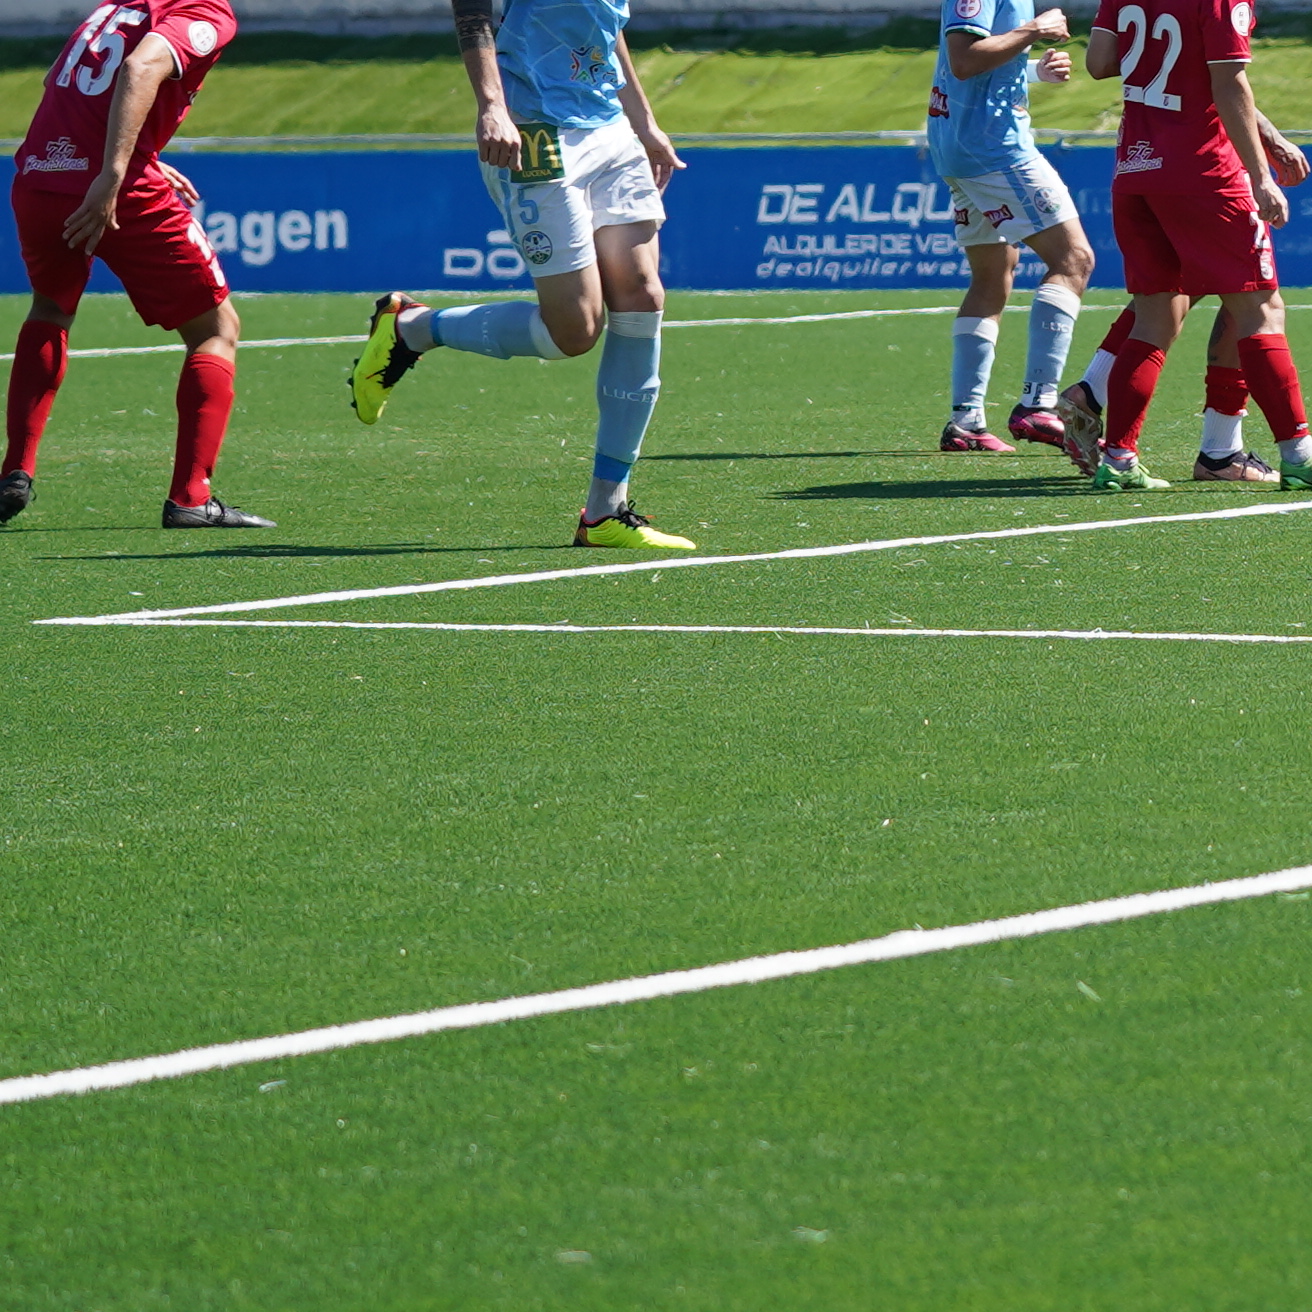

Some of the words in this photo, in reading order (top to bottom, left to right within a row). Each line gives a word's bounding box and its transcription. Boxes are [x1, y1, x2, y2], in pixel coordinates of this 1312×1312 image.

[56, 4, 148, 96] 15
[1117, 4, 1183, 112] 22
[517, 188, 540, 225] 5
[756, 183, 825, 223] DE
